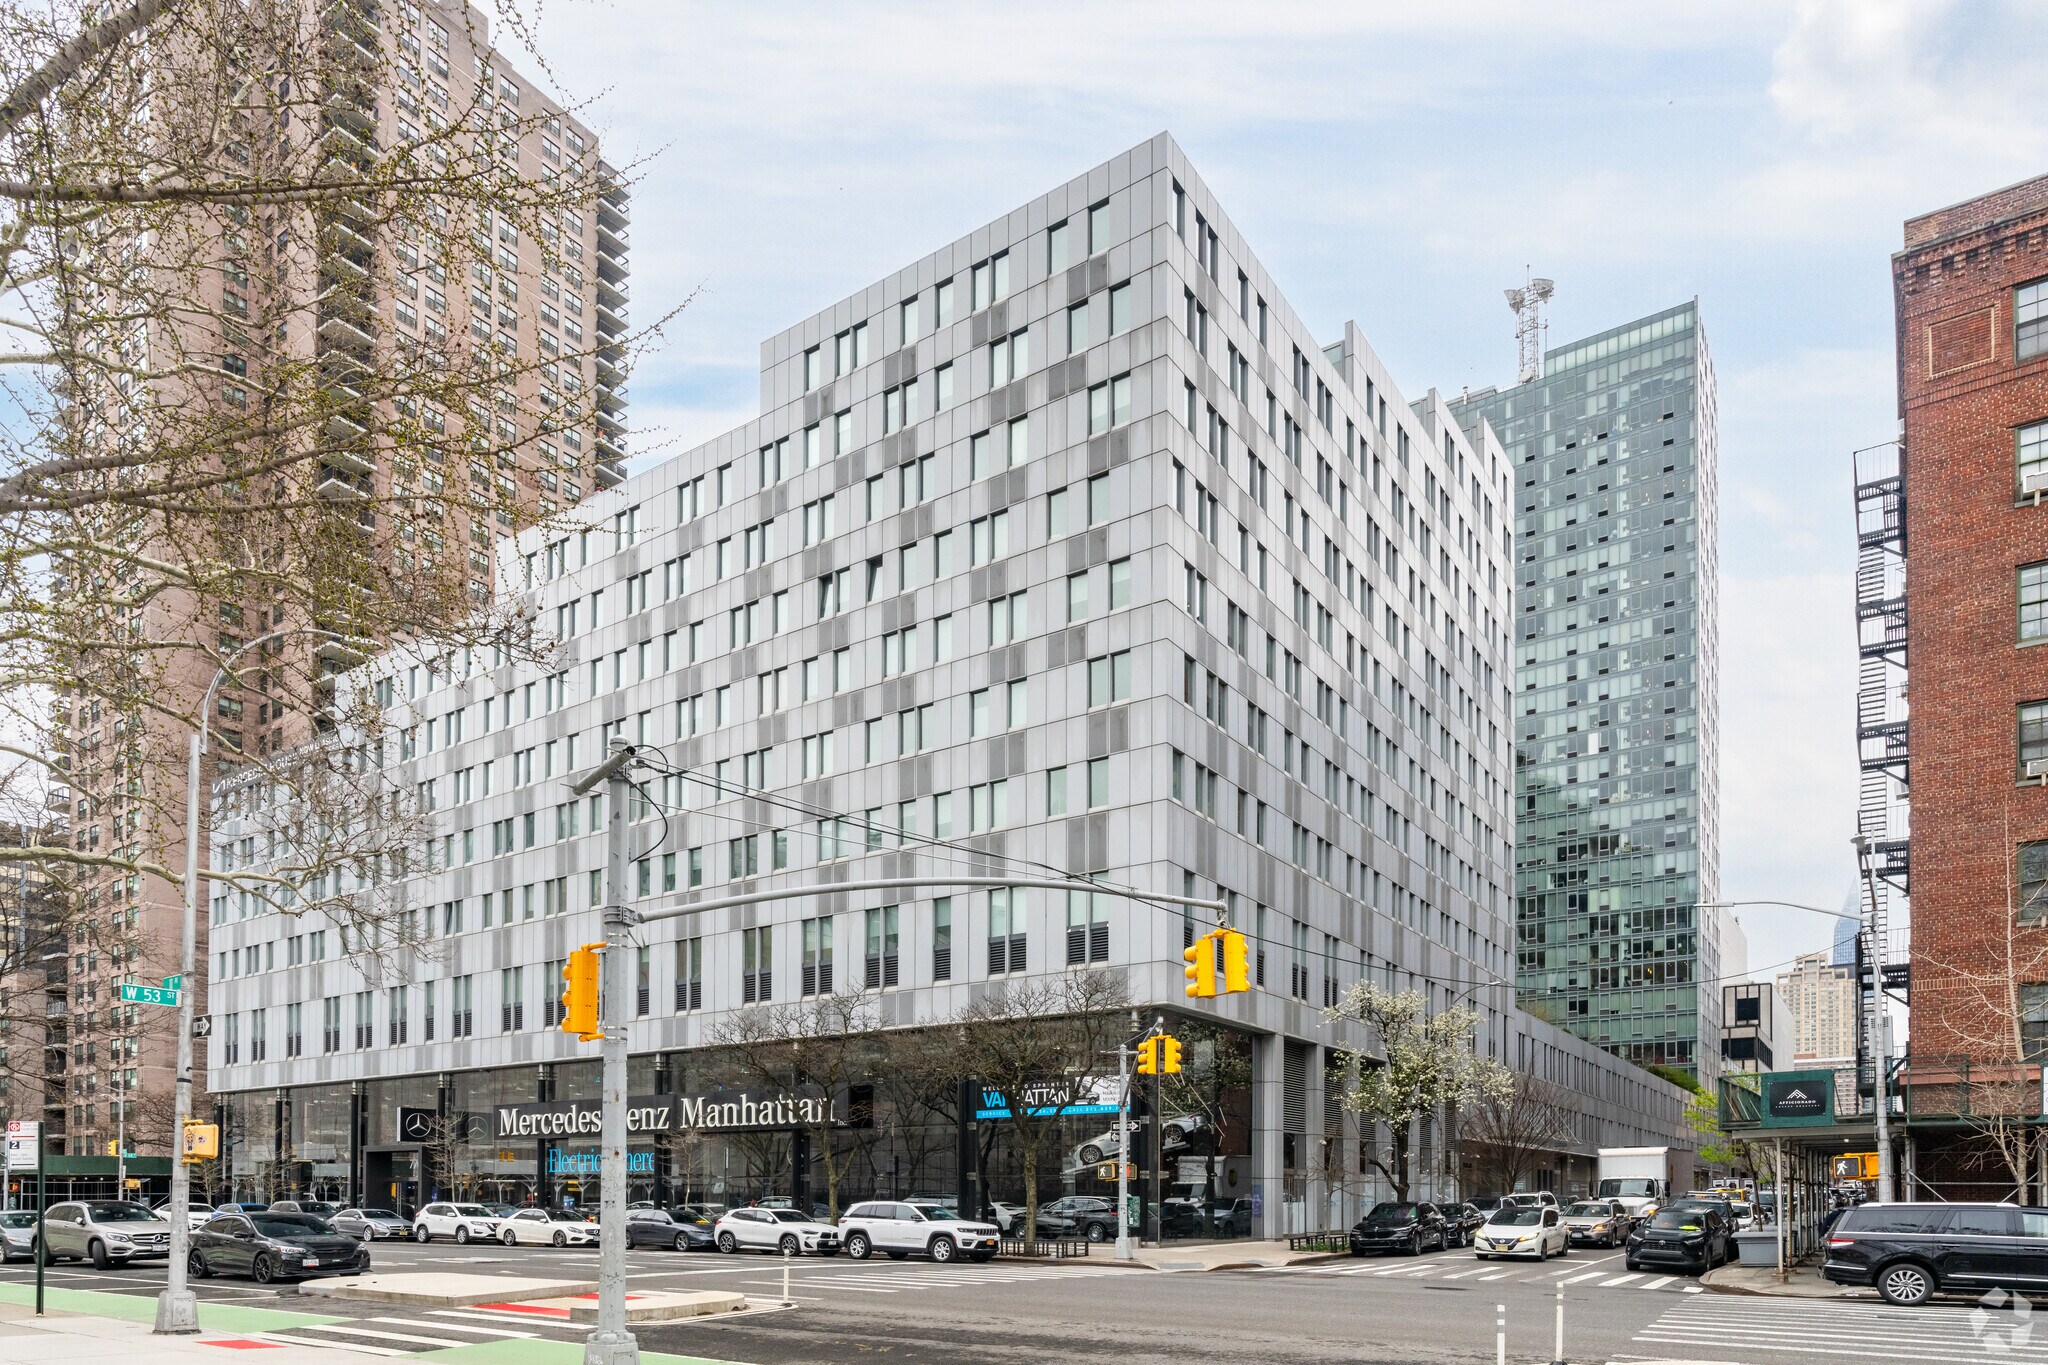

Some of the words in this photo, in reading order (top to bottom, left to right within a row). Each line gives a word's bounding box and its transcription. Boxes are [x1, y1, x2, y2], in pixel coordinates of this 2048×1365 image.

[126, 987, 137, 1000] W
[143, 989, 161, 1003] 53
[167, 991, 175, 999] ST
[982, 1087, 1070, 1108] VAATTAN
[499, 1104, 670, 1136] Mercedesenz
[549, 1147, 602, 1173] Electric
